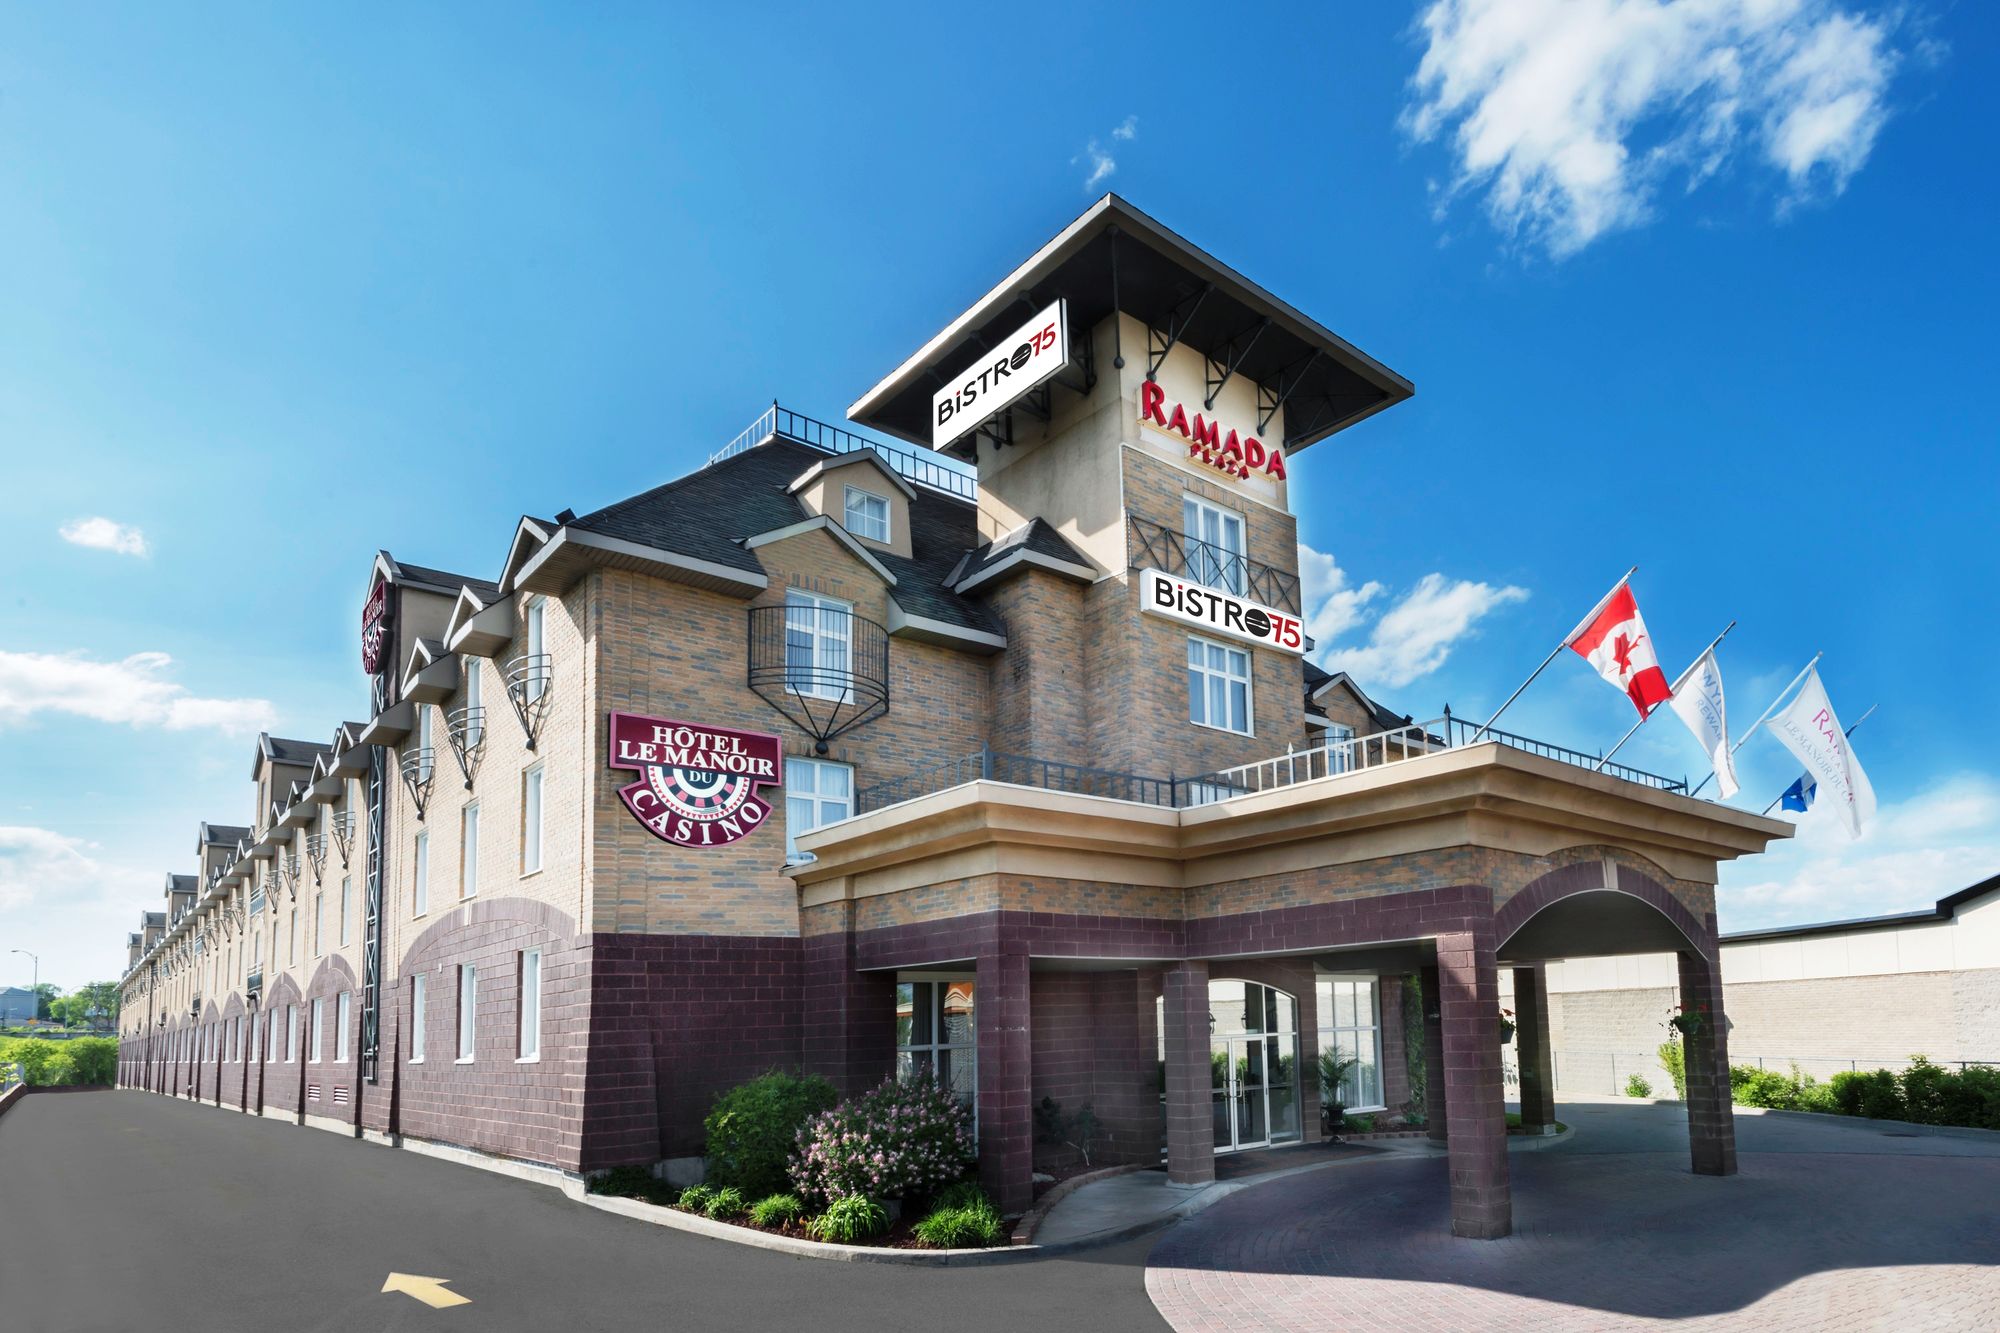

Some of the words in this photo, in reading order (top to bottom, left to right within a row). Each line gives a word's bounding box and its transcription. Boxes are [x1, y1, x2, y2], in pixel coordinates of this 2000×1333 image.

[1142, 379, 1286, 481] RAMADA
[1190, 442, 1250, 480] PLAZA
[618, 740, 658, 762] LE
[663, 746, 775, 776] MANOIR
[651, 725, 748, 756] HÔTEL
[689, 770, 713, 784] DU
[632, 789, 763, 845] CASINO
